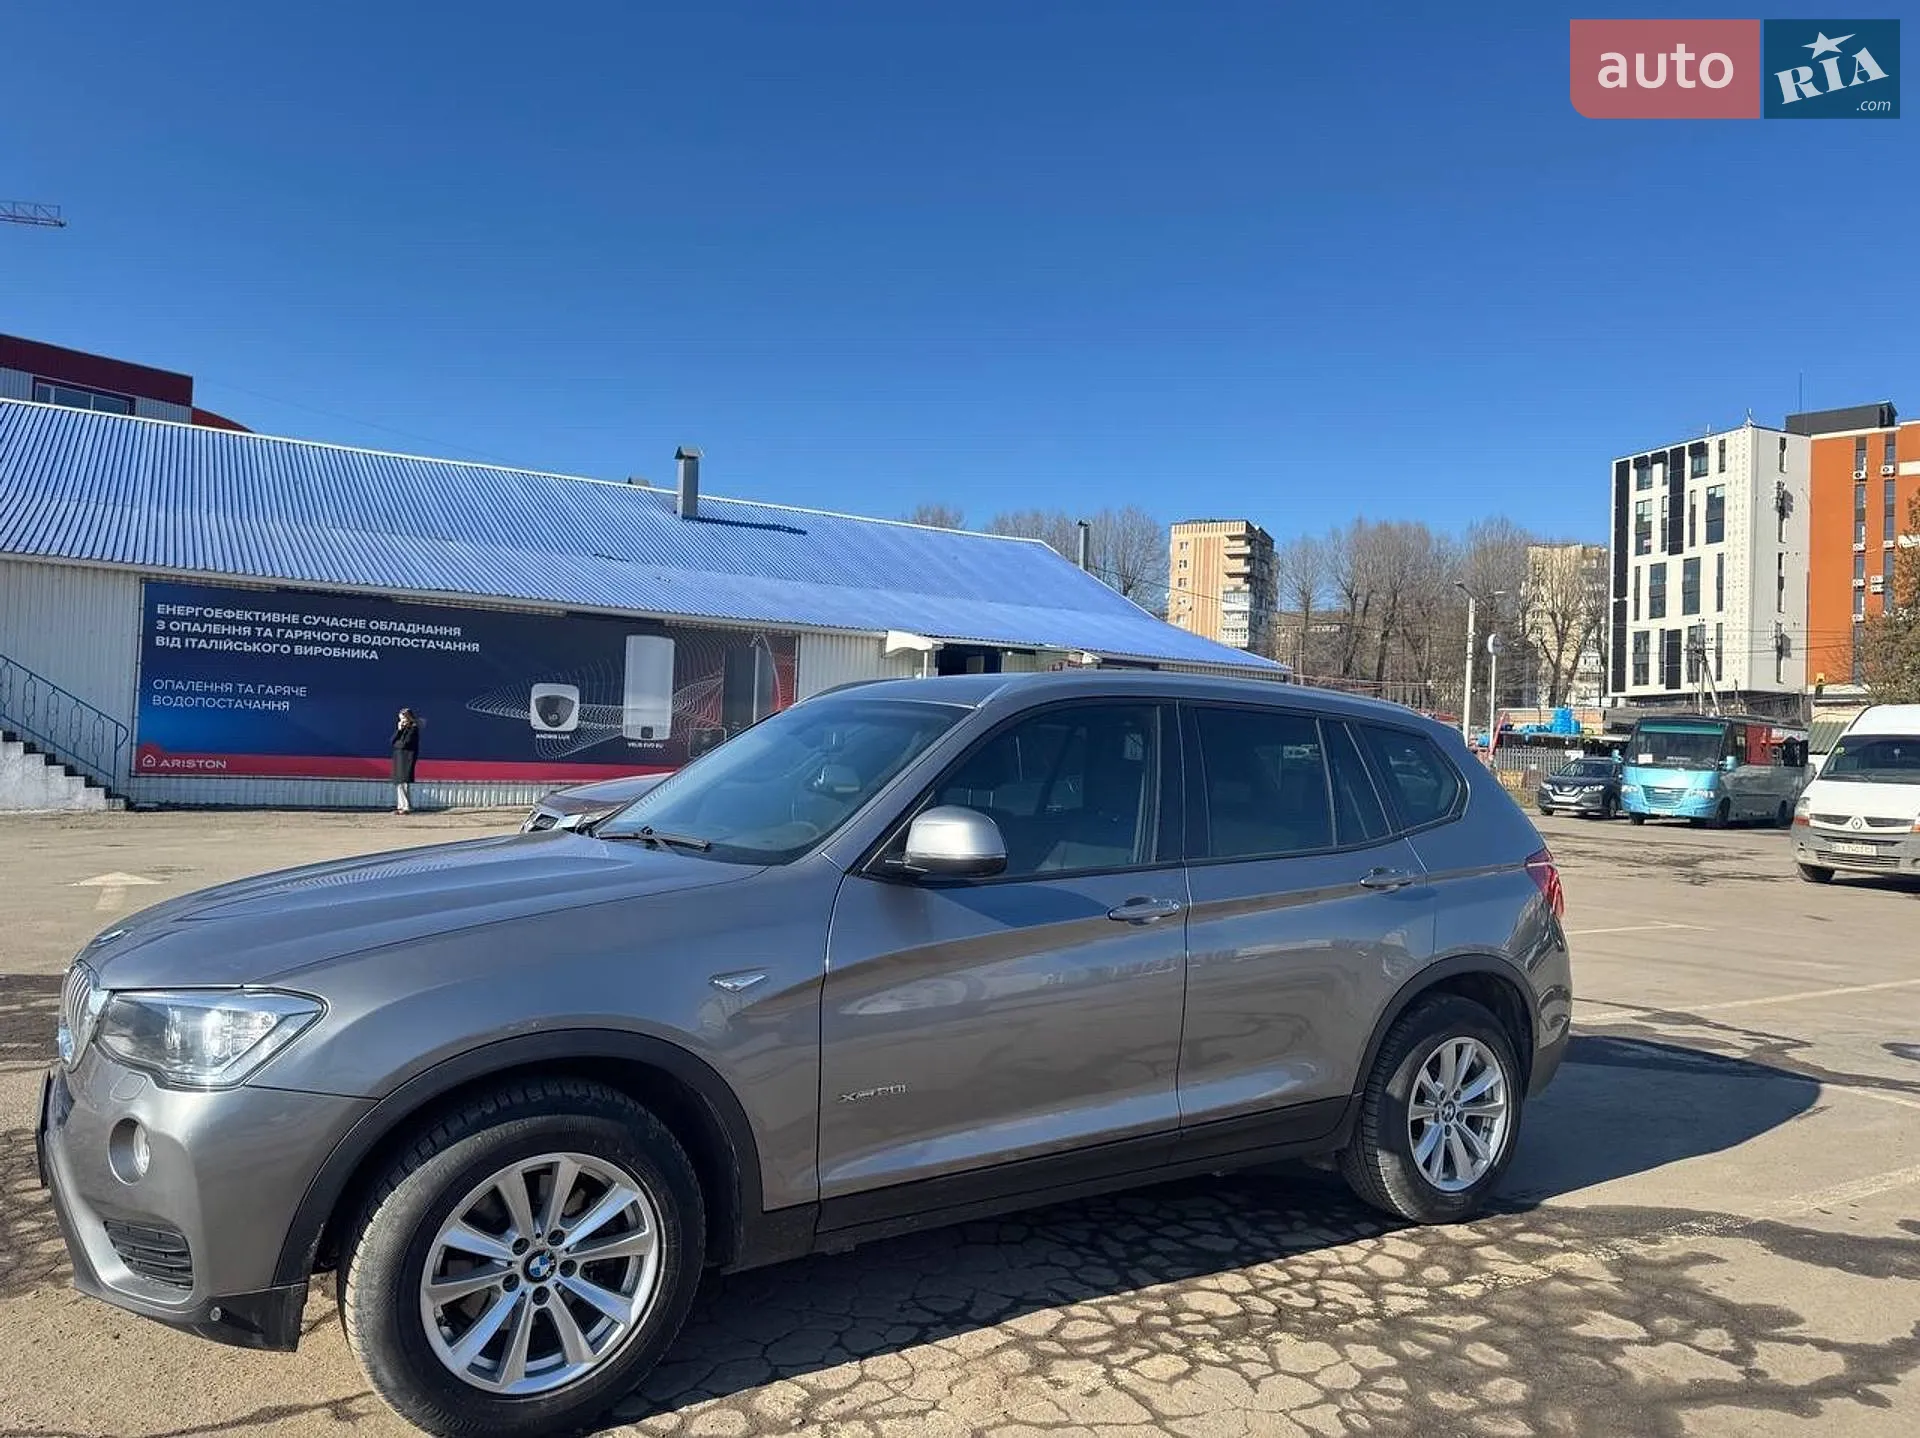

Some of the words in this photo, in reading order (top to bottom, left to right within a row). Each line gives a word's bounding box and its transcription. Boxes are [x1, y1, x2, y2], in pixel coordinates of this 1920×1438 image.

[157, 604, 300, 624] ЕНЕРГОЕФЕКТИВНЕ
[302, 615, 366, 630] СУЧАСНЕ
[369, 620, 462, 637] ОБЛАДНАННЯ
[156, 620, 166, 630] З
[169, 621, 252, 637] ОПАЛЕННЯ
[255, 627, 273, 638] ТА
[276, 629, 350, 643] ГАРЯЧОГО
[353, 633, 480, 653] ВОДОПОСТАЧАННЯ
[155, 636, 182, 649] ВІД
[184, 638, 291, 654] ІТАЛІЙСЬКОГО
[294, 645, 379, 660] ВИРОБНИКА
[152, 679, 233, 694] ОПАЛЕННЯ
[237, 683, 255, 694] ТА
[257, 684, 308, 697] ГАРЯЧЕ
[152, 695, 290, 711] ВОДОПОСТАЧАННЯ
[159, 759, 227, 769] ARISTON
